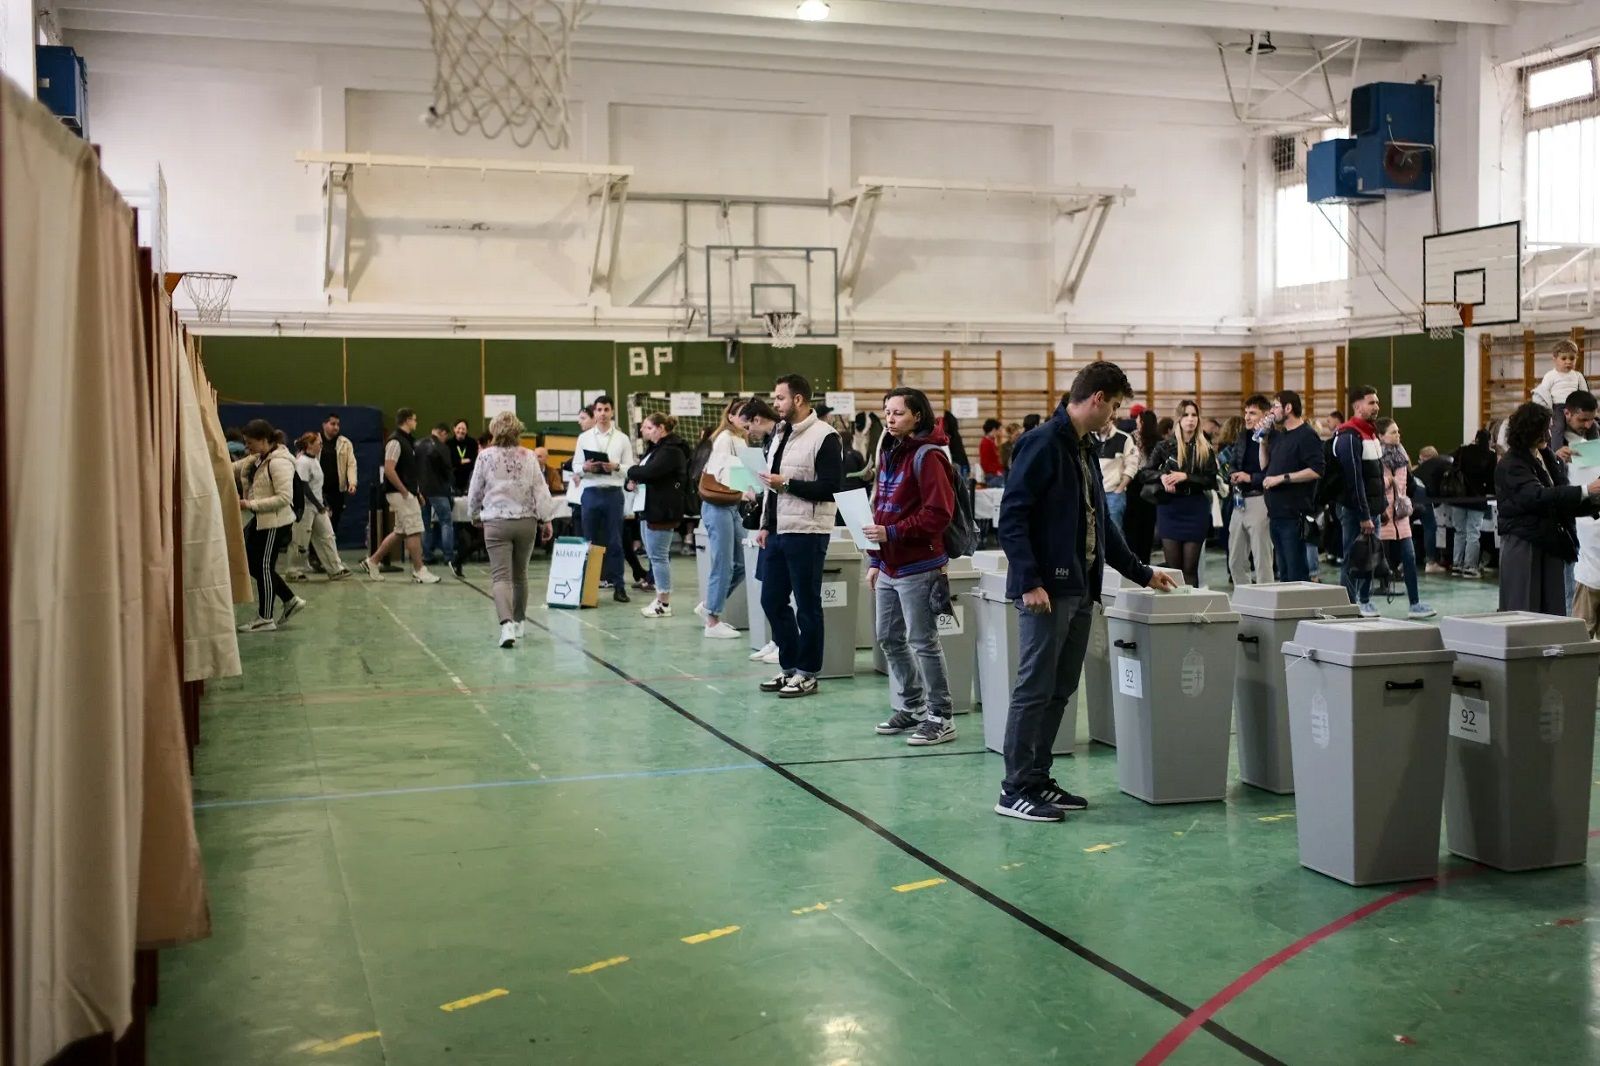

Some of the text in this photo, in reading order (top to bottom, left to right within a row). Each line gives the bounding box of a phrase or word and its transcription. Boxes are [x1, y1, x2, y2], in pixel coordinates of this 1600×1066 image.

[629, 346, 672, 376] BP
[1055, 567, 1069, 576] HH
[824, 589, 836, 599] 92
[939, 615, 952, 626] 92
[1125, 669, 1134, 683] 92
[1461, 708, 1476, 726] 92
